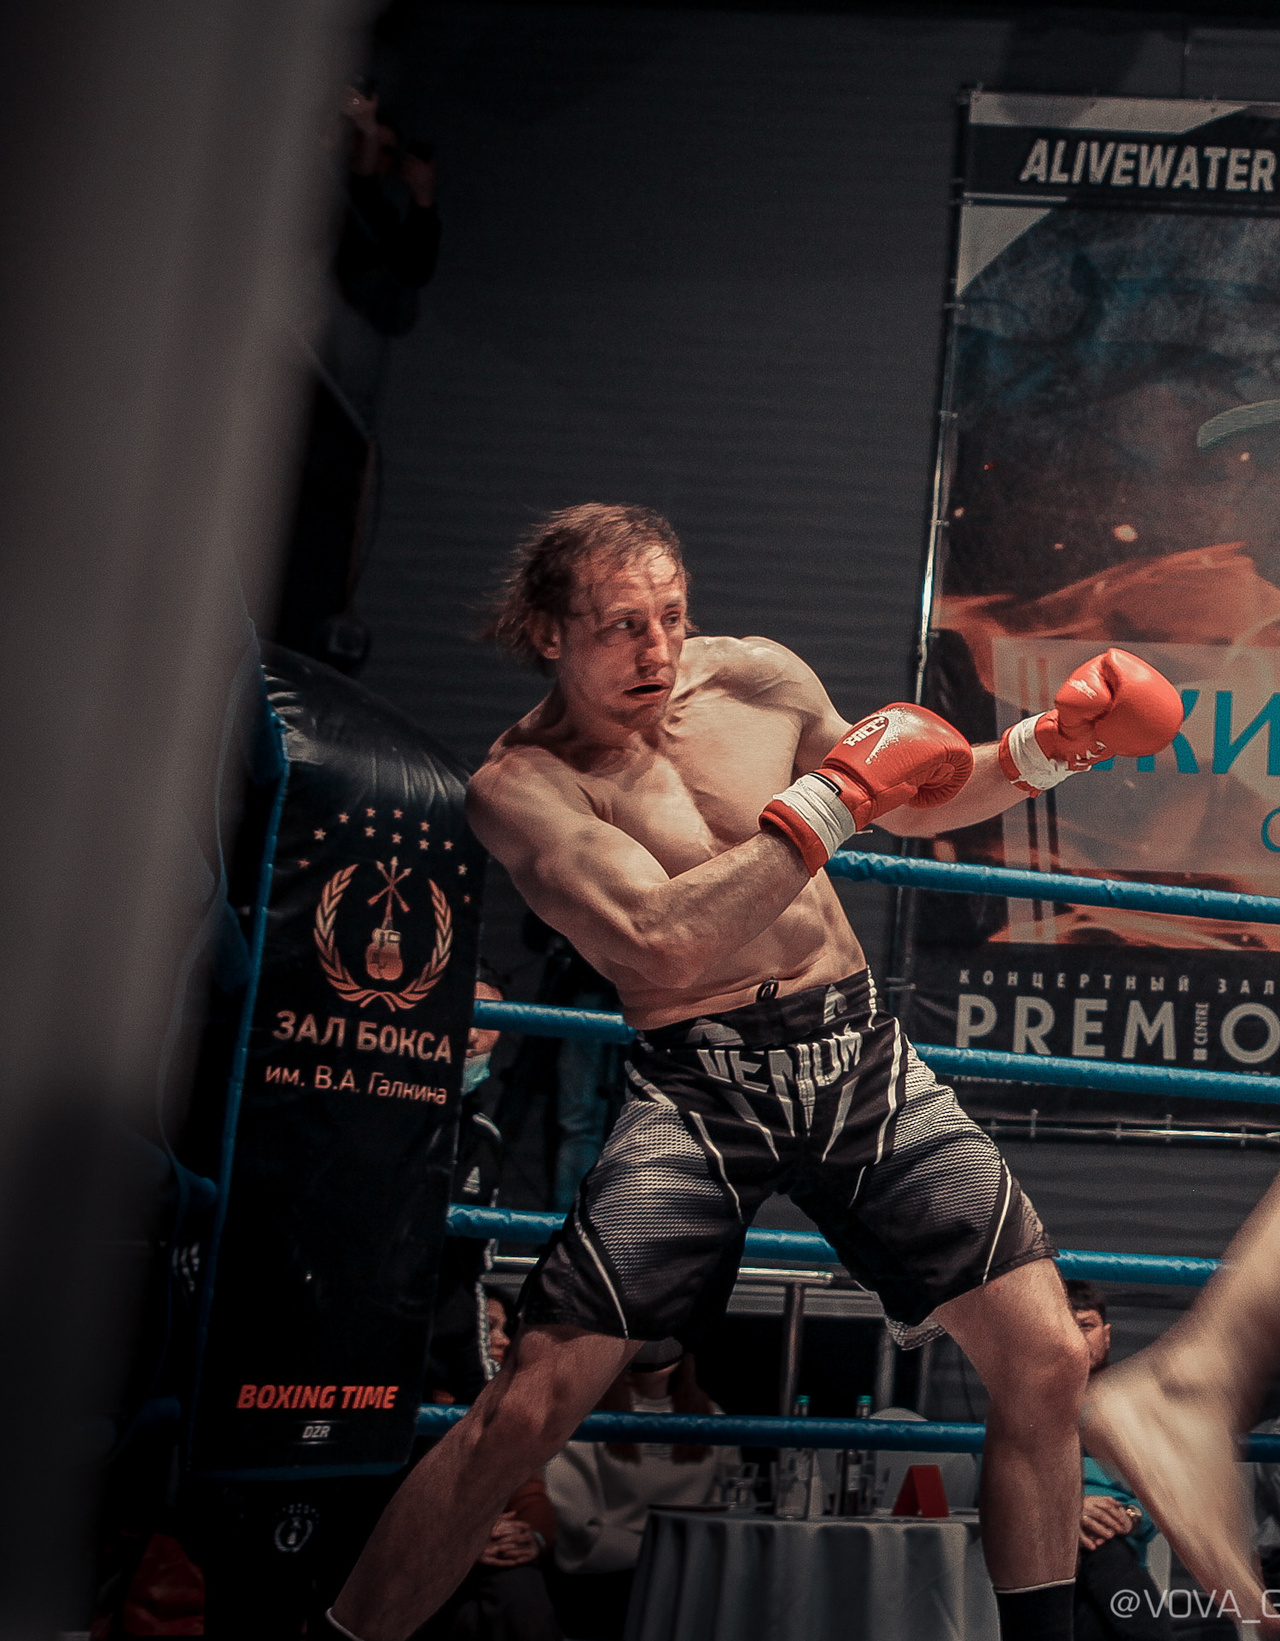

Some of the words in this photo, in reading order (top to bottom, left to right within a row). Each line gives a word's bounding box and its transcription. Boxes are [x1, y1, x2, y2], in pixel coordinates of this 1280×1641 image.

[1020, 138, 1277, 194] ALIVEWATER
[958, 969, 1190, 993] КОНЦЕРТНЫЙ
[1217, 978, 1275, 996] ЗАЛ
[272, 1010, 346, 1048] ЗАЛ
[356, 1021, 452, 1065] БОКСА
[265, 1065, 305, 1087] им.
[314, 1065, 360, 1094] В.А.
[367, 1071, 448, 1106] Галкина
[236, 1384, 337, 1409] BOXING
[341, 1385, 399, 1409] TIME
[302, 1425, 331, 1438] DZR
